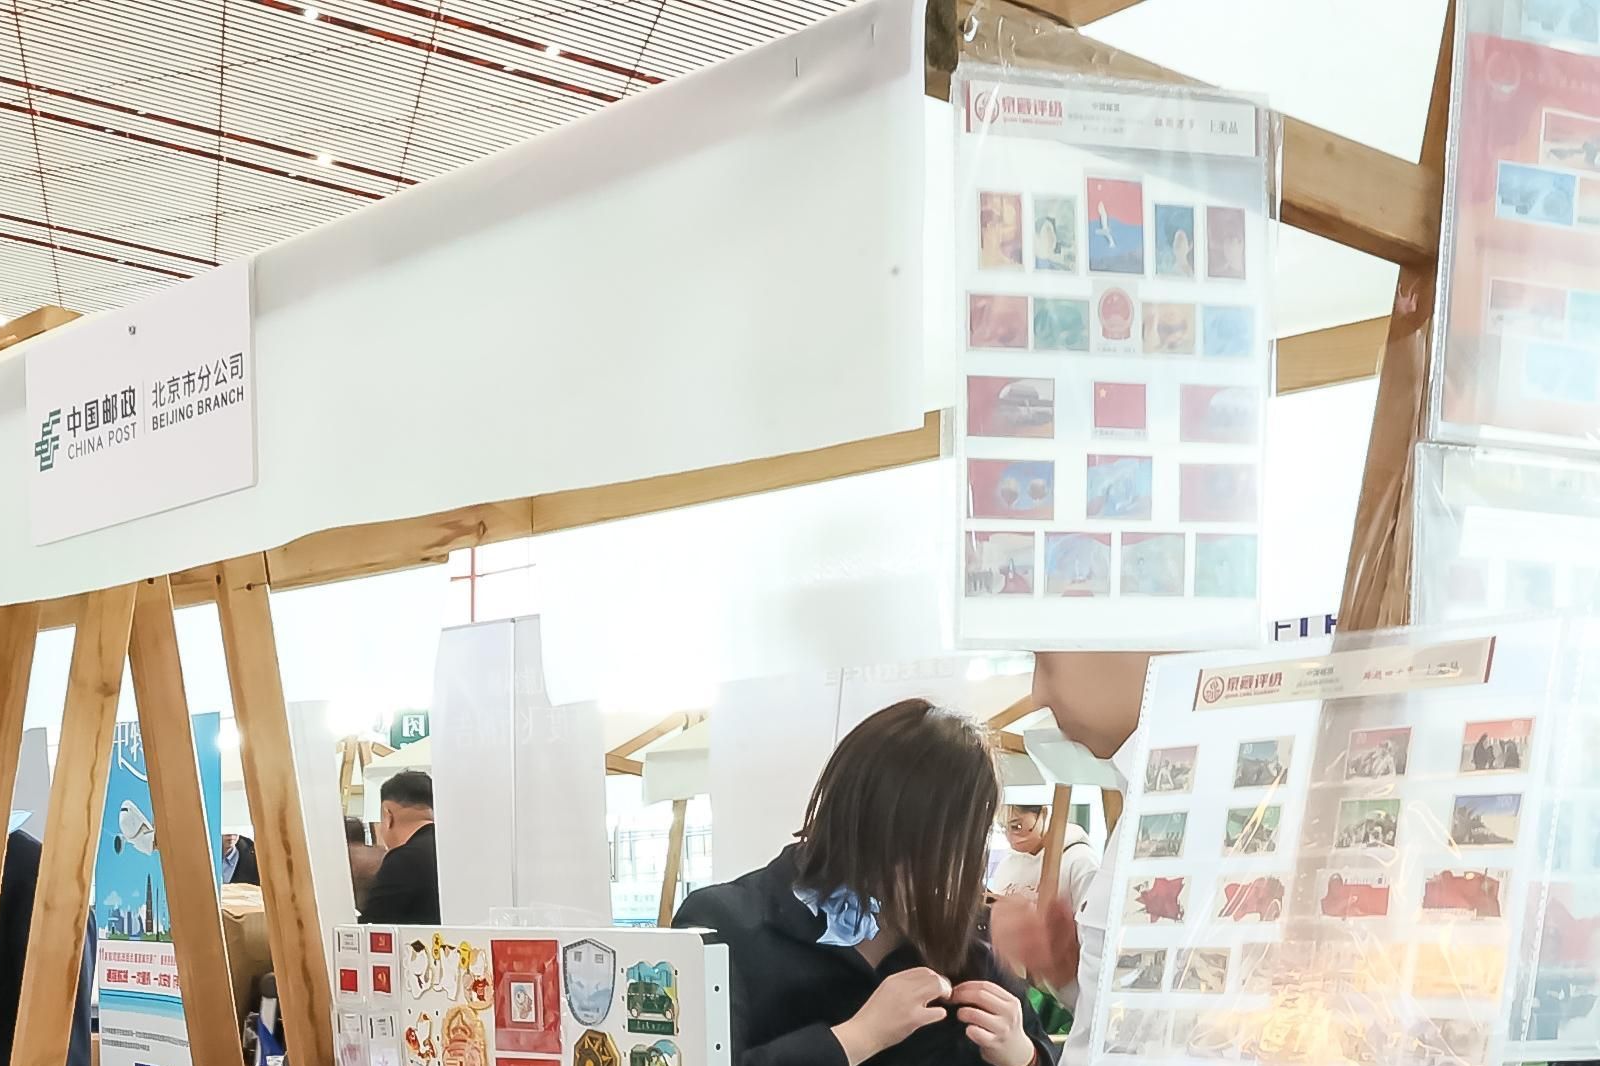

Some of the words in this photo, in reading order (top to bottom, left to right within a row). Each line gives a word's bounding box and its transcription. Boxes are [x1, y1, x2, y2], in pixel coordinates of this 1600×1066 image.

[151, 352, 244, 409] 北京市分公司
[67, 385, 137, 438] 中国邮政
[152, 403, 194, 431] BEIJING
[197, 385, 244, 416] BRANCH
[67, 434, 104, 460] CHINA
[109, 422, 137, 448] POST
